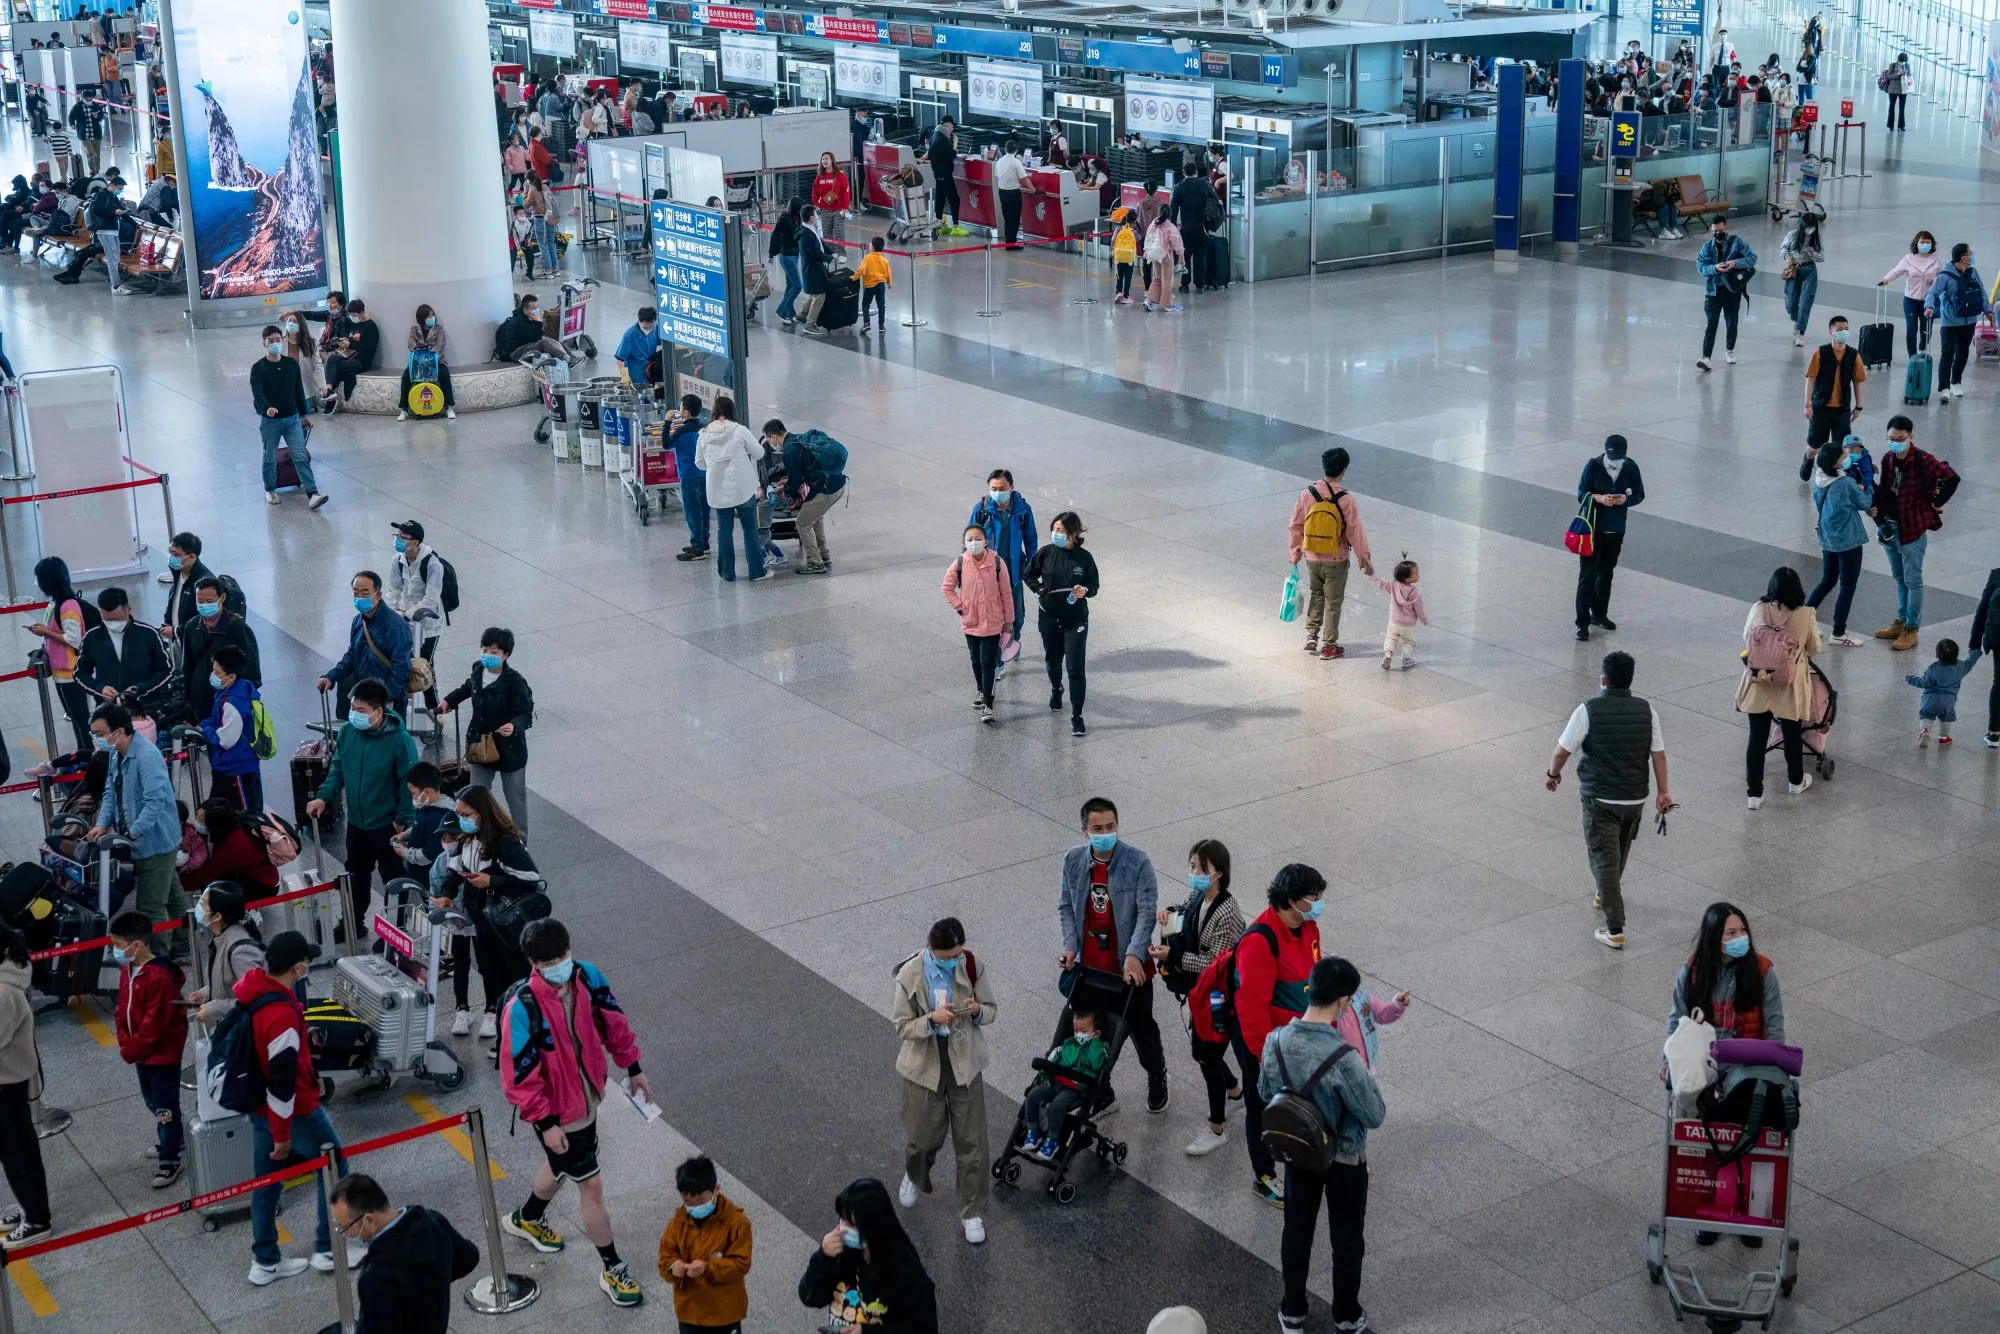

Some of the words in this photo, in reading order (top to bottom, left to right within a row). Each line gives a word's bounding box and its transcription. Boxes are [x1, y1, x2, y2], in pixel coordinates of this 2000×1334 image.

[756, 17, 764, 25] J24
[825, 20, 876, 32] 国内航班全自动行李托运
[806, 22, 814, 31] J23
[878, 29, 888, 38] J22
[936, 33, 946, 44] J21
[1019, 41, 1031, 51] J20
[1087, 48, 1099, 60] J19
[1185, 58, 1199, 68] J18
[1266, 64, 1280, 76] J17
[690, 270, 706, 284] 洗手间
[690, 283, 700, 291] Toilet
